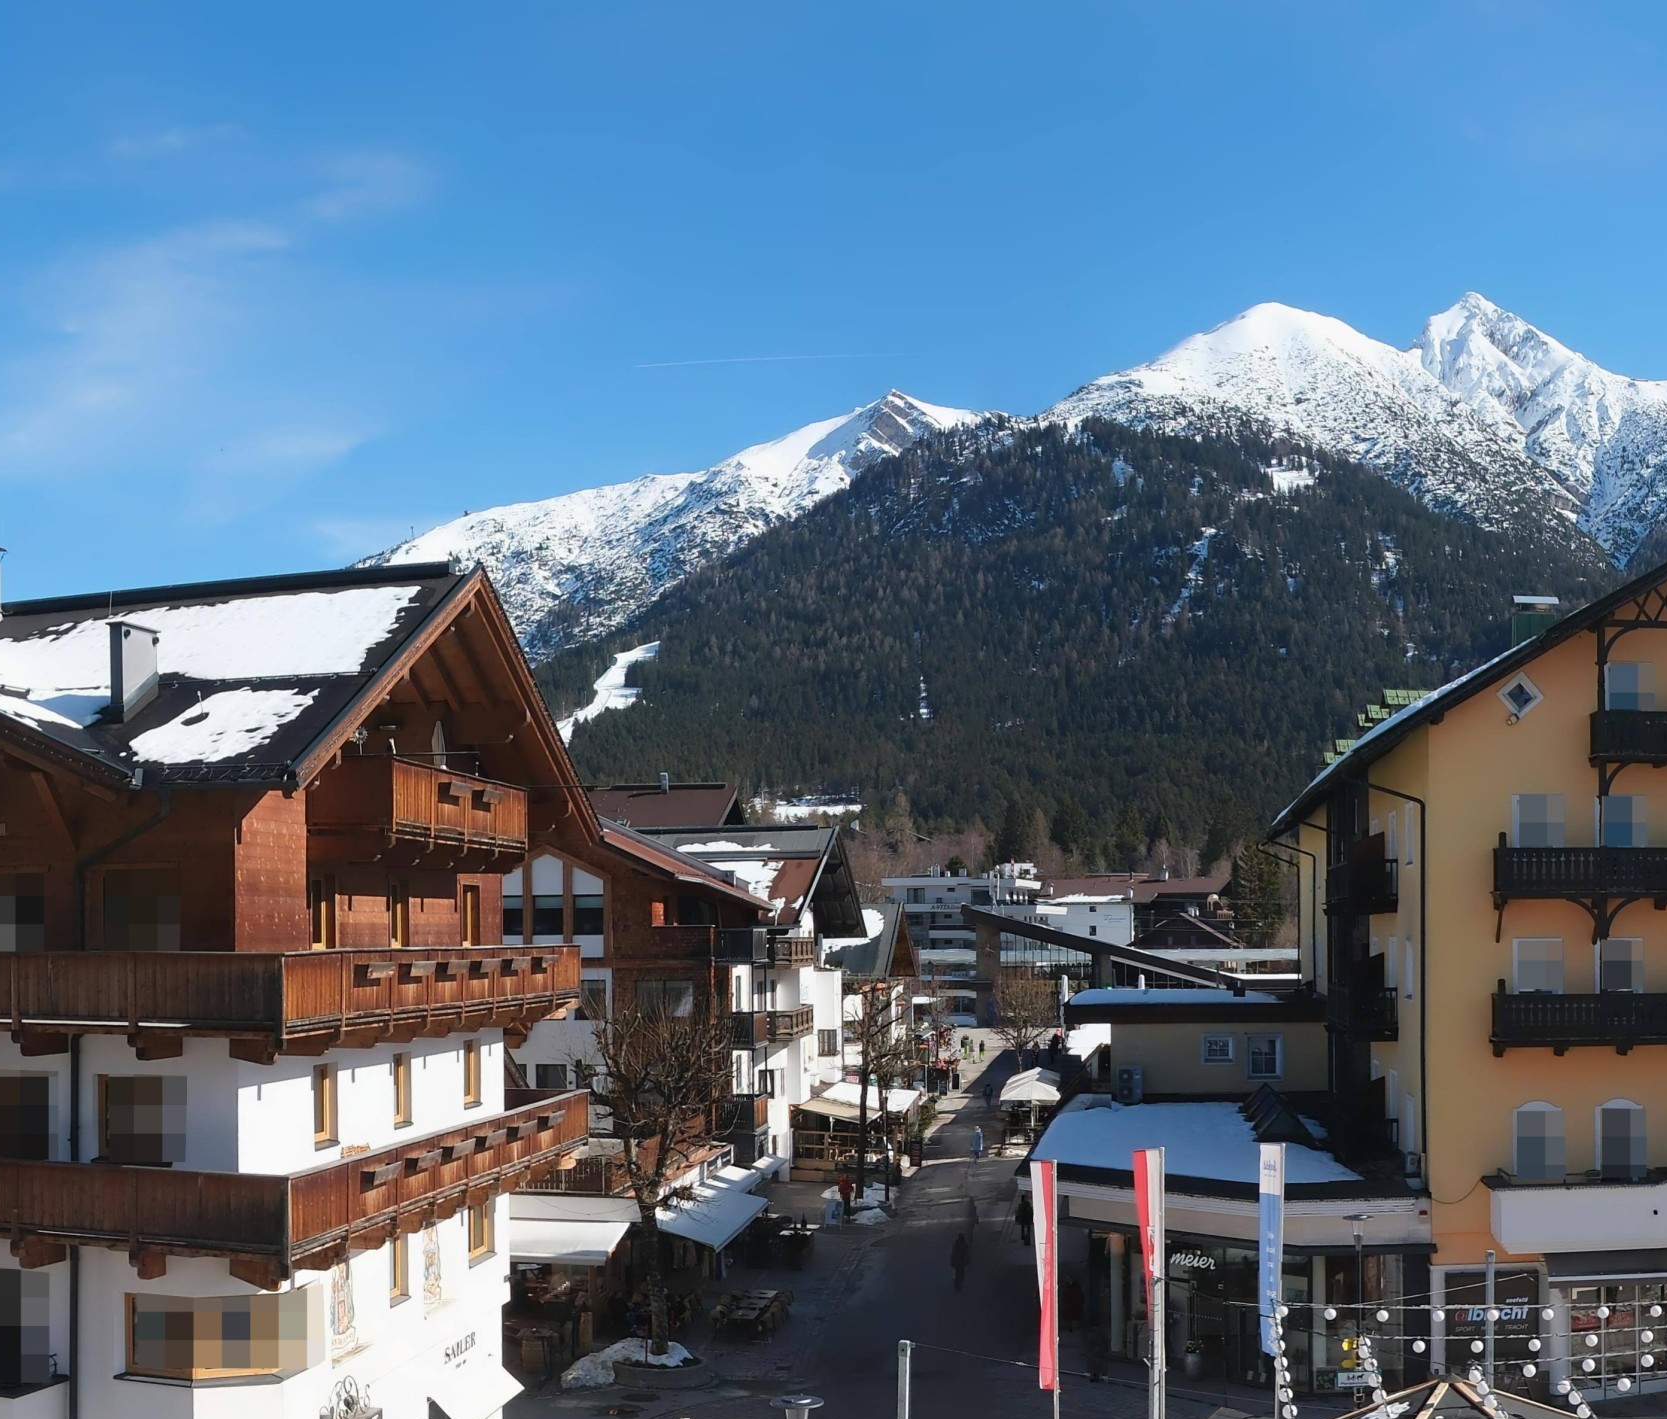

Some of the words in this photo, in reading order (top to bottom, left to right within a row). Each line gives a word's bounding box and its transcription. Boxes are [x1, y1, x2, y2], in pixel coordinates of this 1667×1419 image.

[1170, 1250, 1216, 1271] meier
[1455, 1325, 1475, 1333] SPORT
[444, 1331, 476, 1365] SAILER
